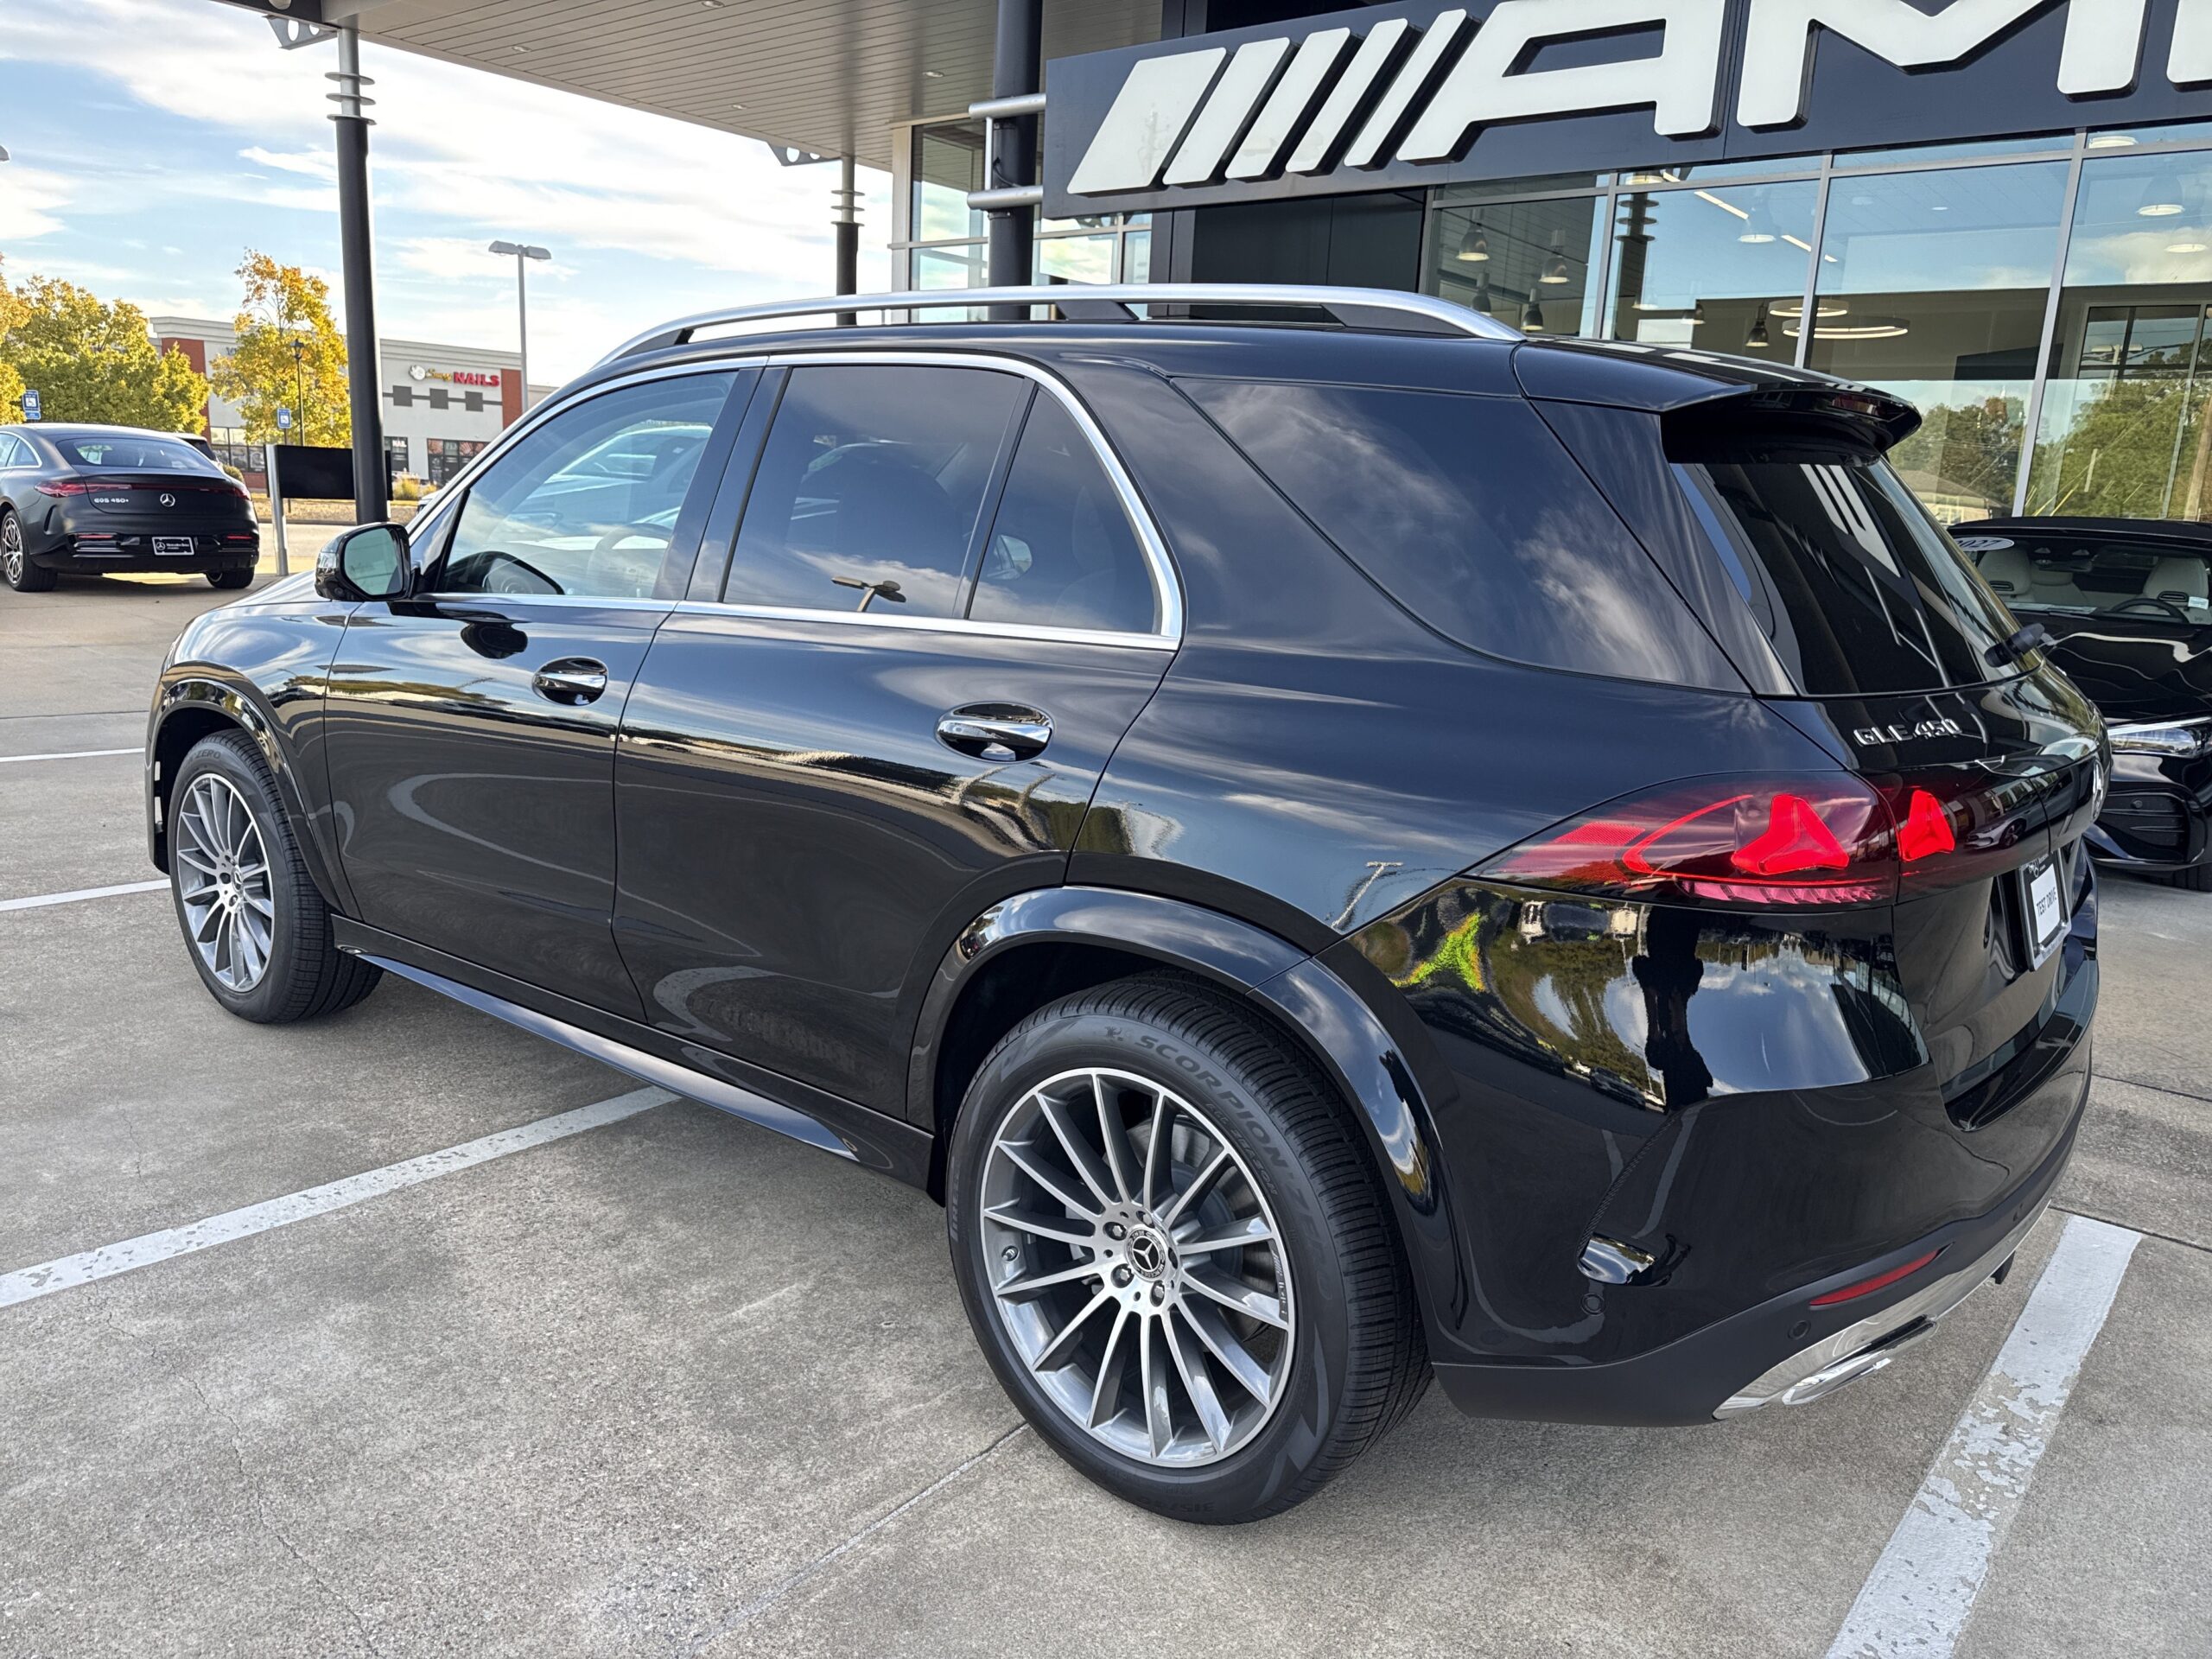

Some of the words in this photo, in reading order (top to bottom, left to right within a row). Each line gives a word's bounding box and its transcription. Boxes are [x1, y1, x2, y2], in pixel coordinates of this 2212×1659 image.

[1396, 0, 2212, 163] AM
[454, 372, 499, 386] NAILS
[1853, 724, 1913, 746] GLE
[1915, 718, 1963, 737] 450
[195, 748, 221, 760] ZERO
[2037, 897, 2046, 916] TEST
[2046, 887, 2056, 908] DRIVE
[1135, 1035, 1289, 1167] SCORPION
